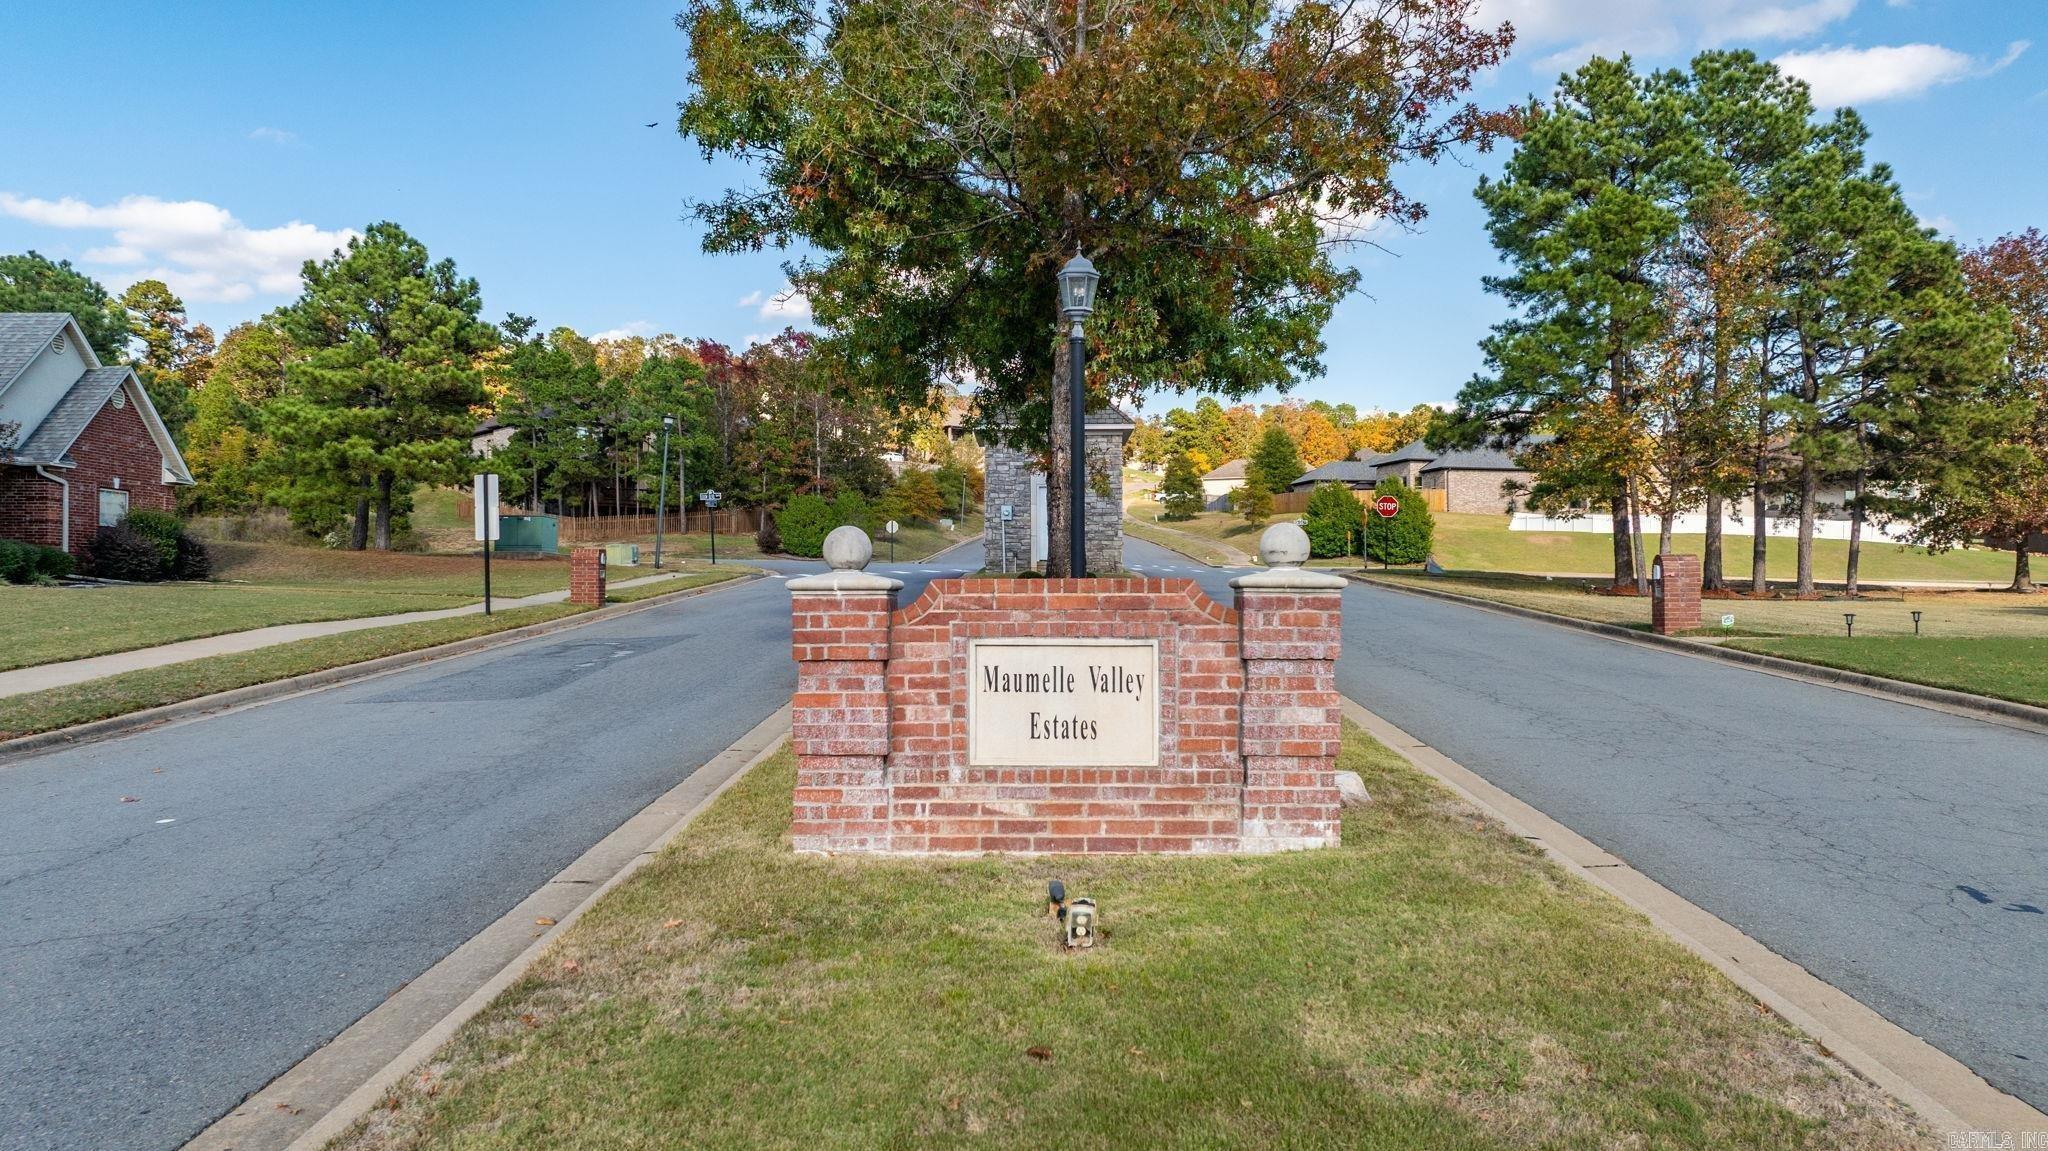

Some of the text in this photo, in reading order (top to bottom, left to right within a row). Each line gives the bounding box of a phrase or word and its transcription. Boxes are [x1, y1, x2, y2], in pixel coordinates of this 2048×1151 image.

[1378, 502, 1396, 510] STOP
[983, 665, 1145, 702] Maumelle Valley
[1029, 712, 1098, 740] Estates
